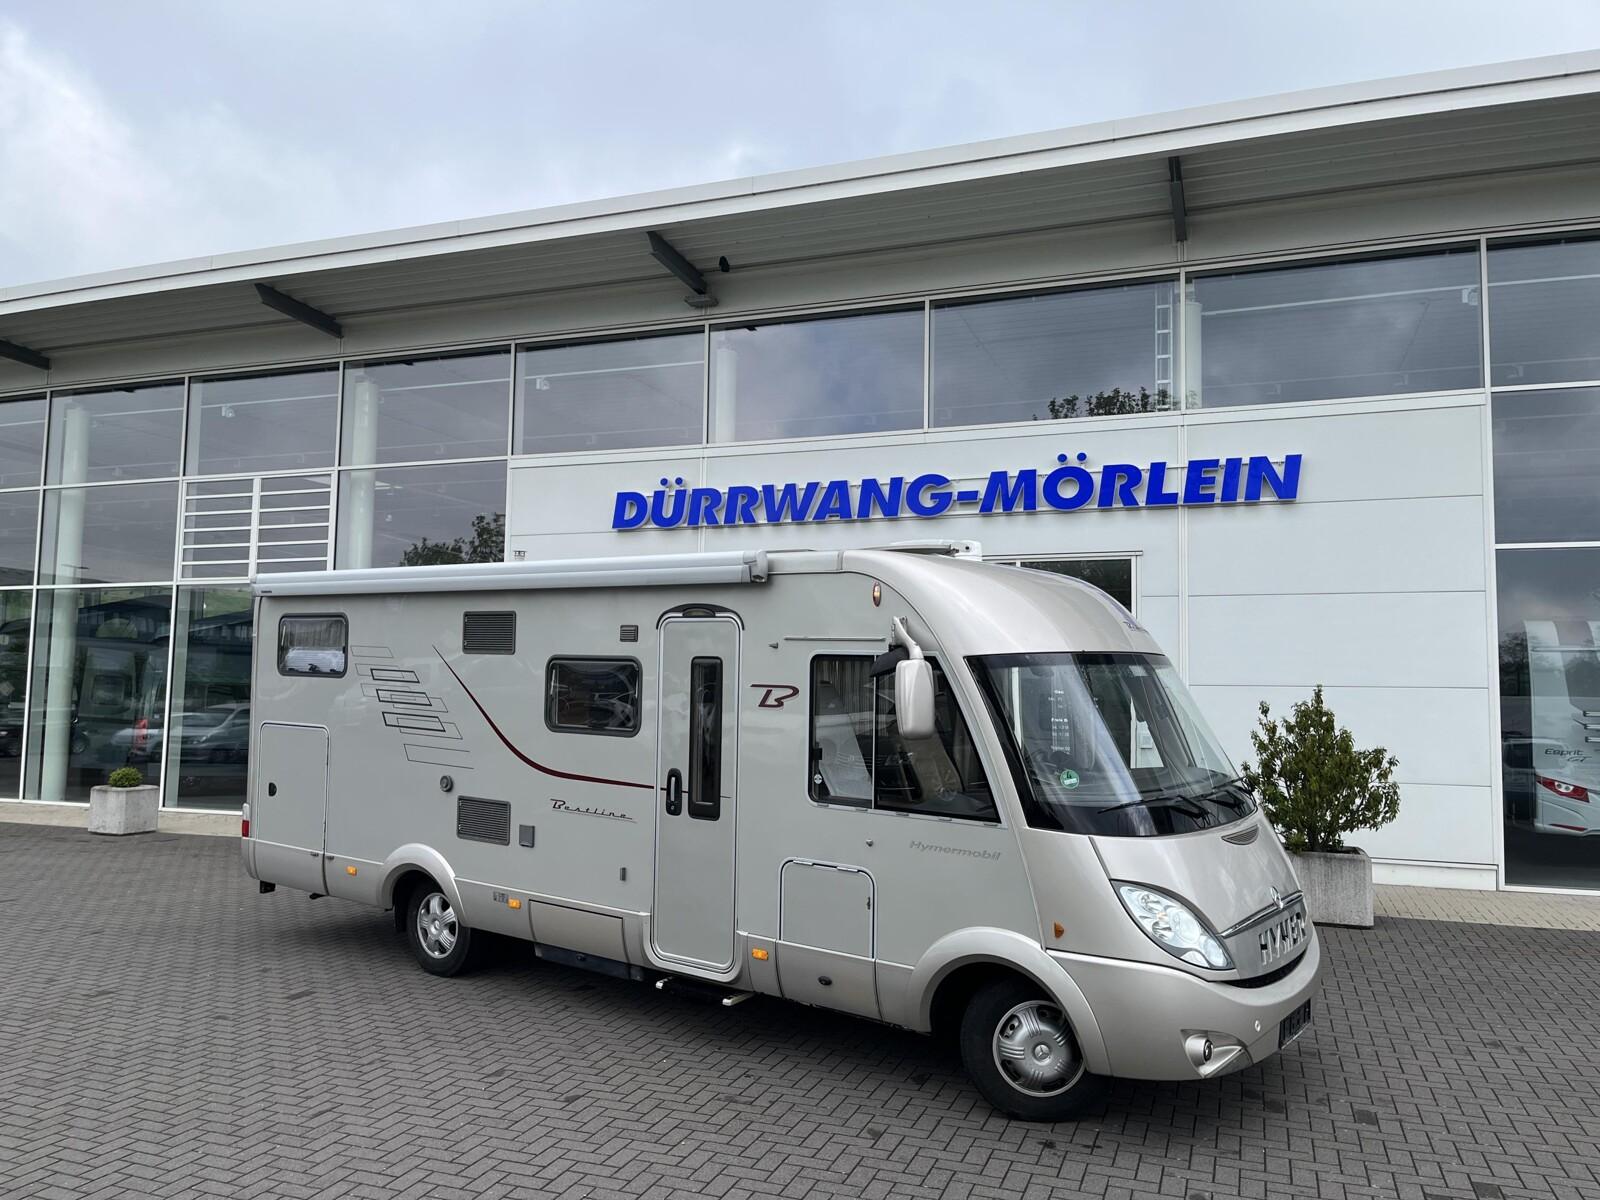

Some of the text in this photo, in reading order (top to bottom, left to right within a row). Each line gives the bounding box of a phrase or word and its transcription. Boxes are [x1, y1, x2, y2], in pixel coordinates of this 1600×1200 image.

[612, 453, 1302, 531] DÜRRWANG-MÖRLEIN
[1544, 748, 1584, 756] Esprit
[550, 798, 634, 820] Bestline
[909, 840, 1001, 861] Hymermobil
[1258, 912, 1307, 965] HYMER
